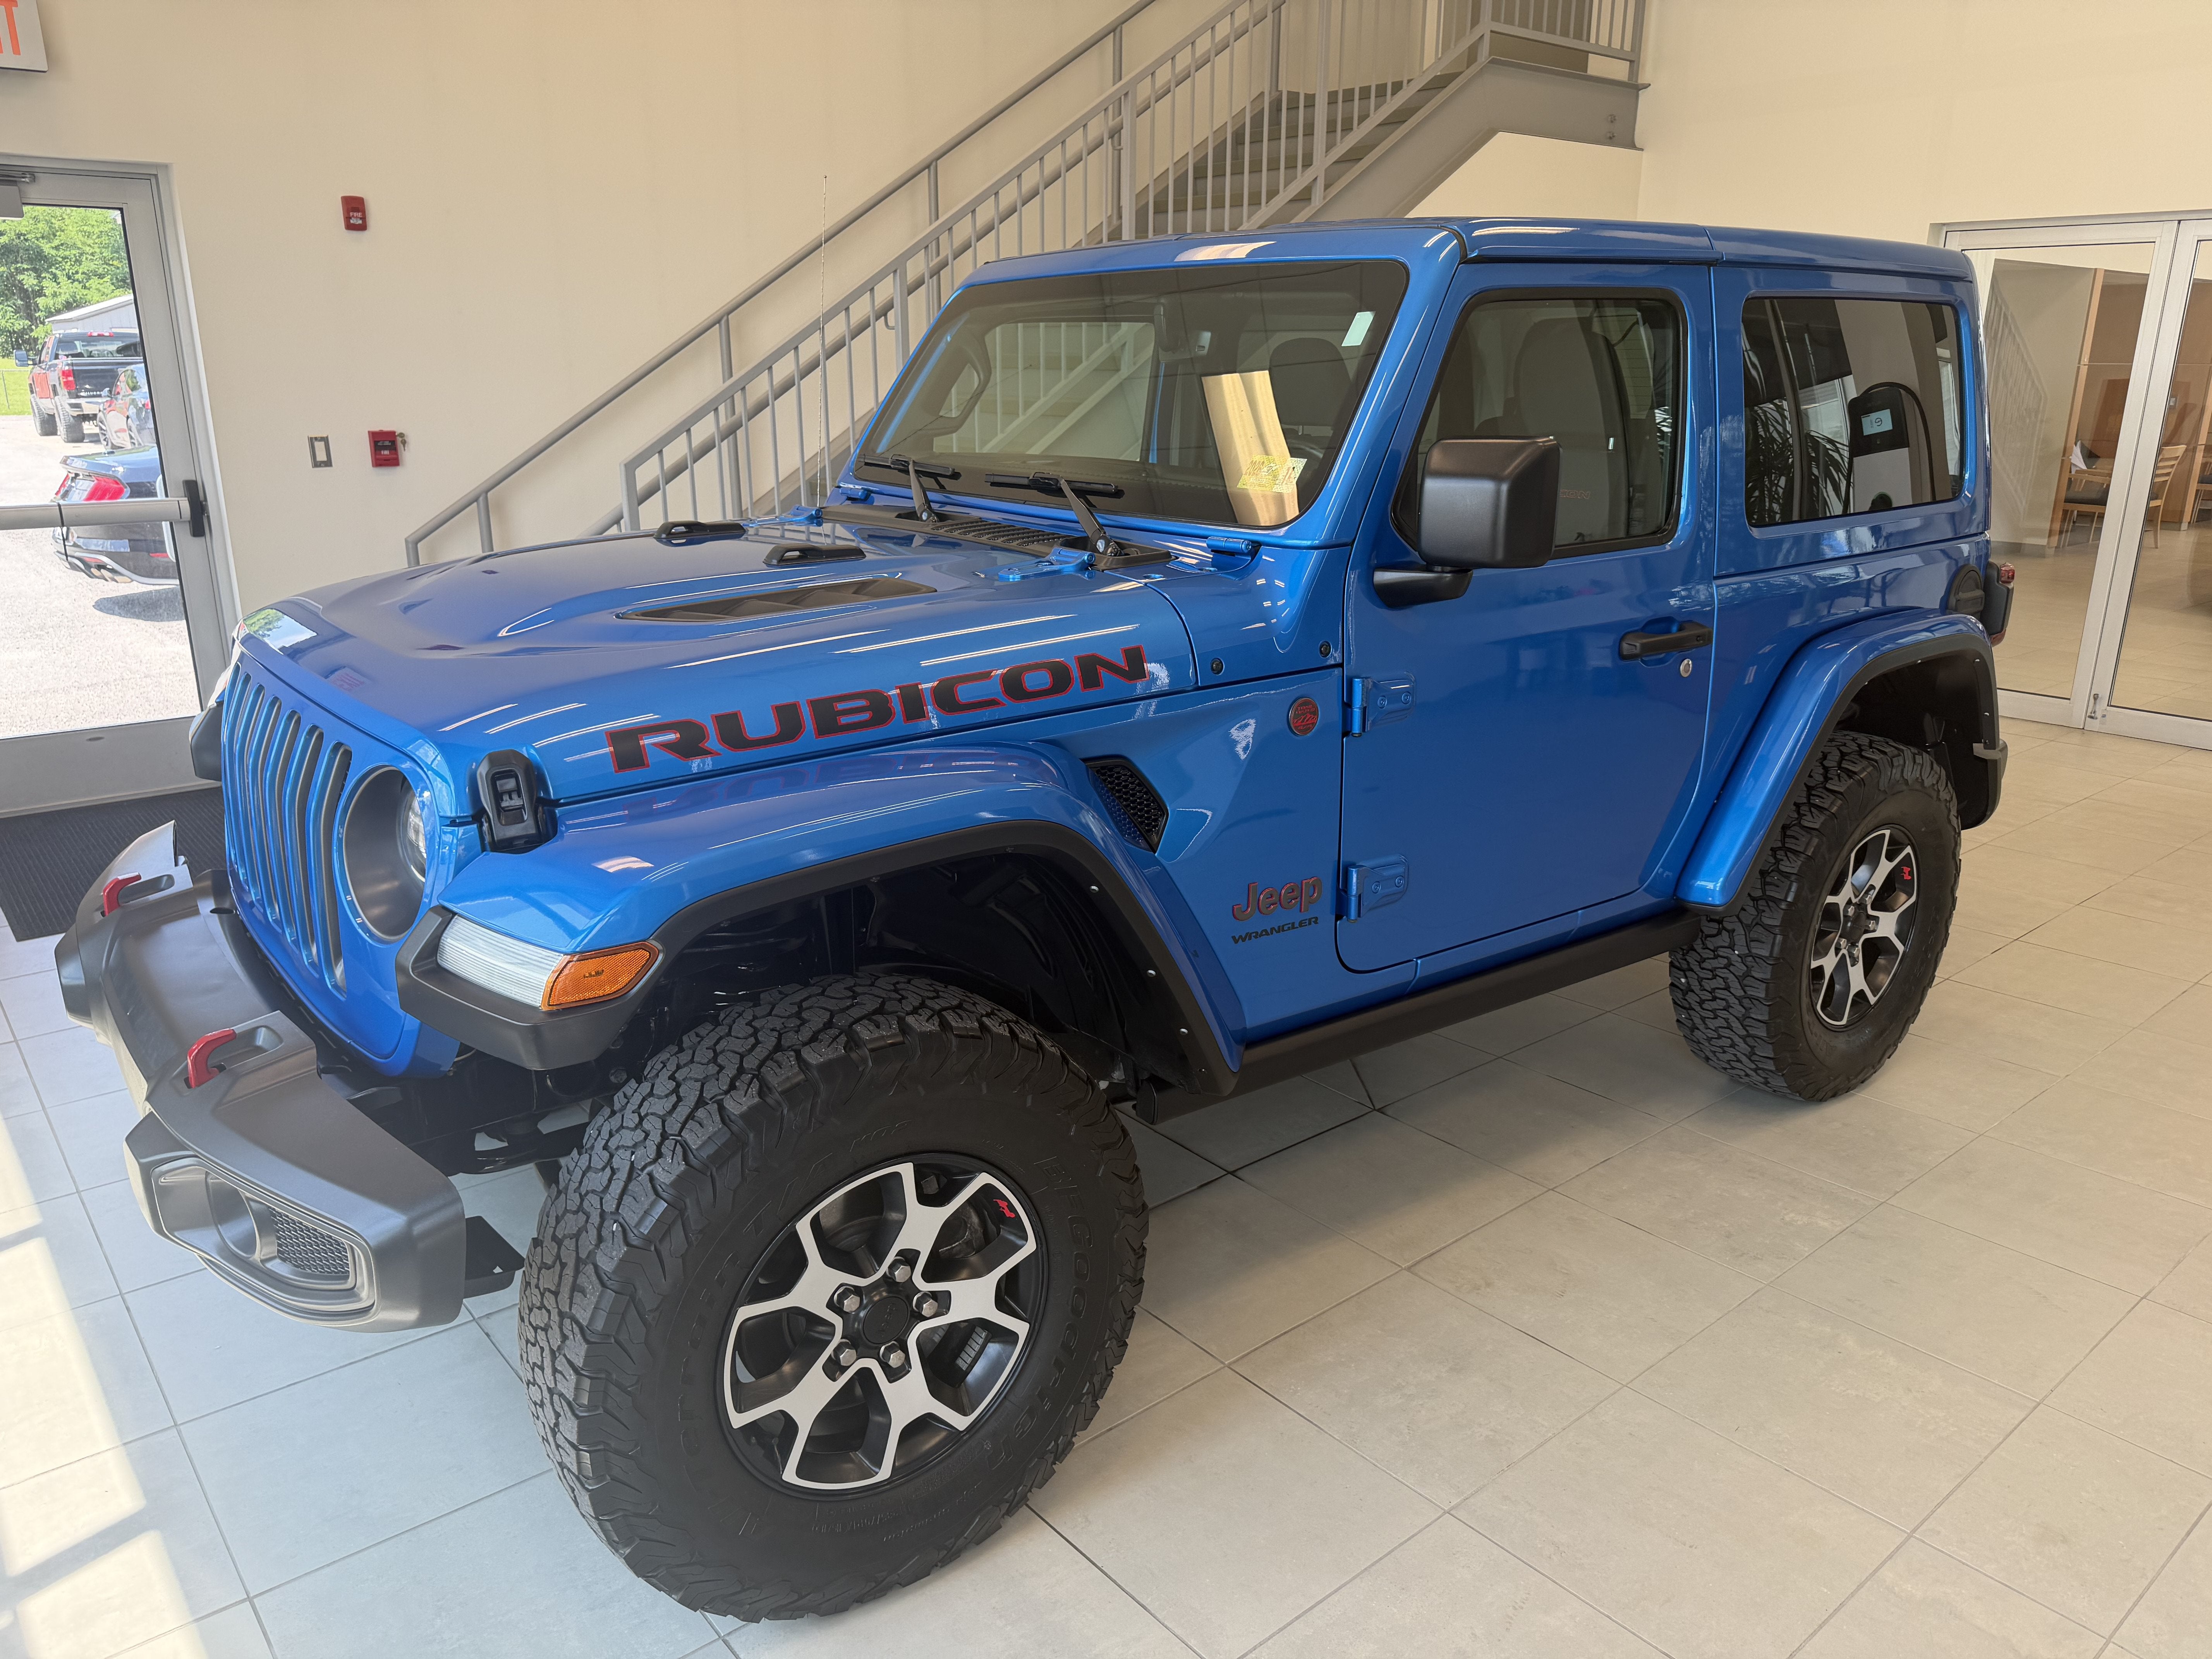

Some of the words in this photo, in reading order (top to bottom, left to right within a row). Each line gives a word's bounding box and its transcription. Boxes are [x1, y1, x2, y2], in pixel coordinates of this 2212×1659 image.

[605, 644, 1150, 773] RUBICON
[1232, 876, 1322, 921] Jeep
[1231, 916, 1319, 944] WRANGLER
